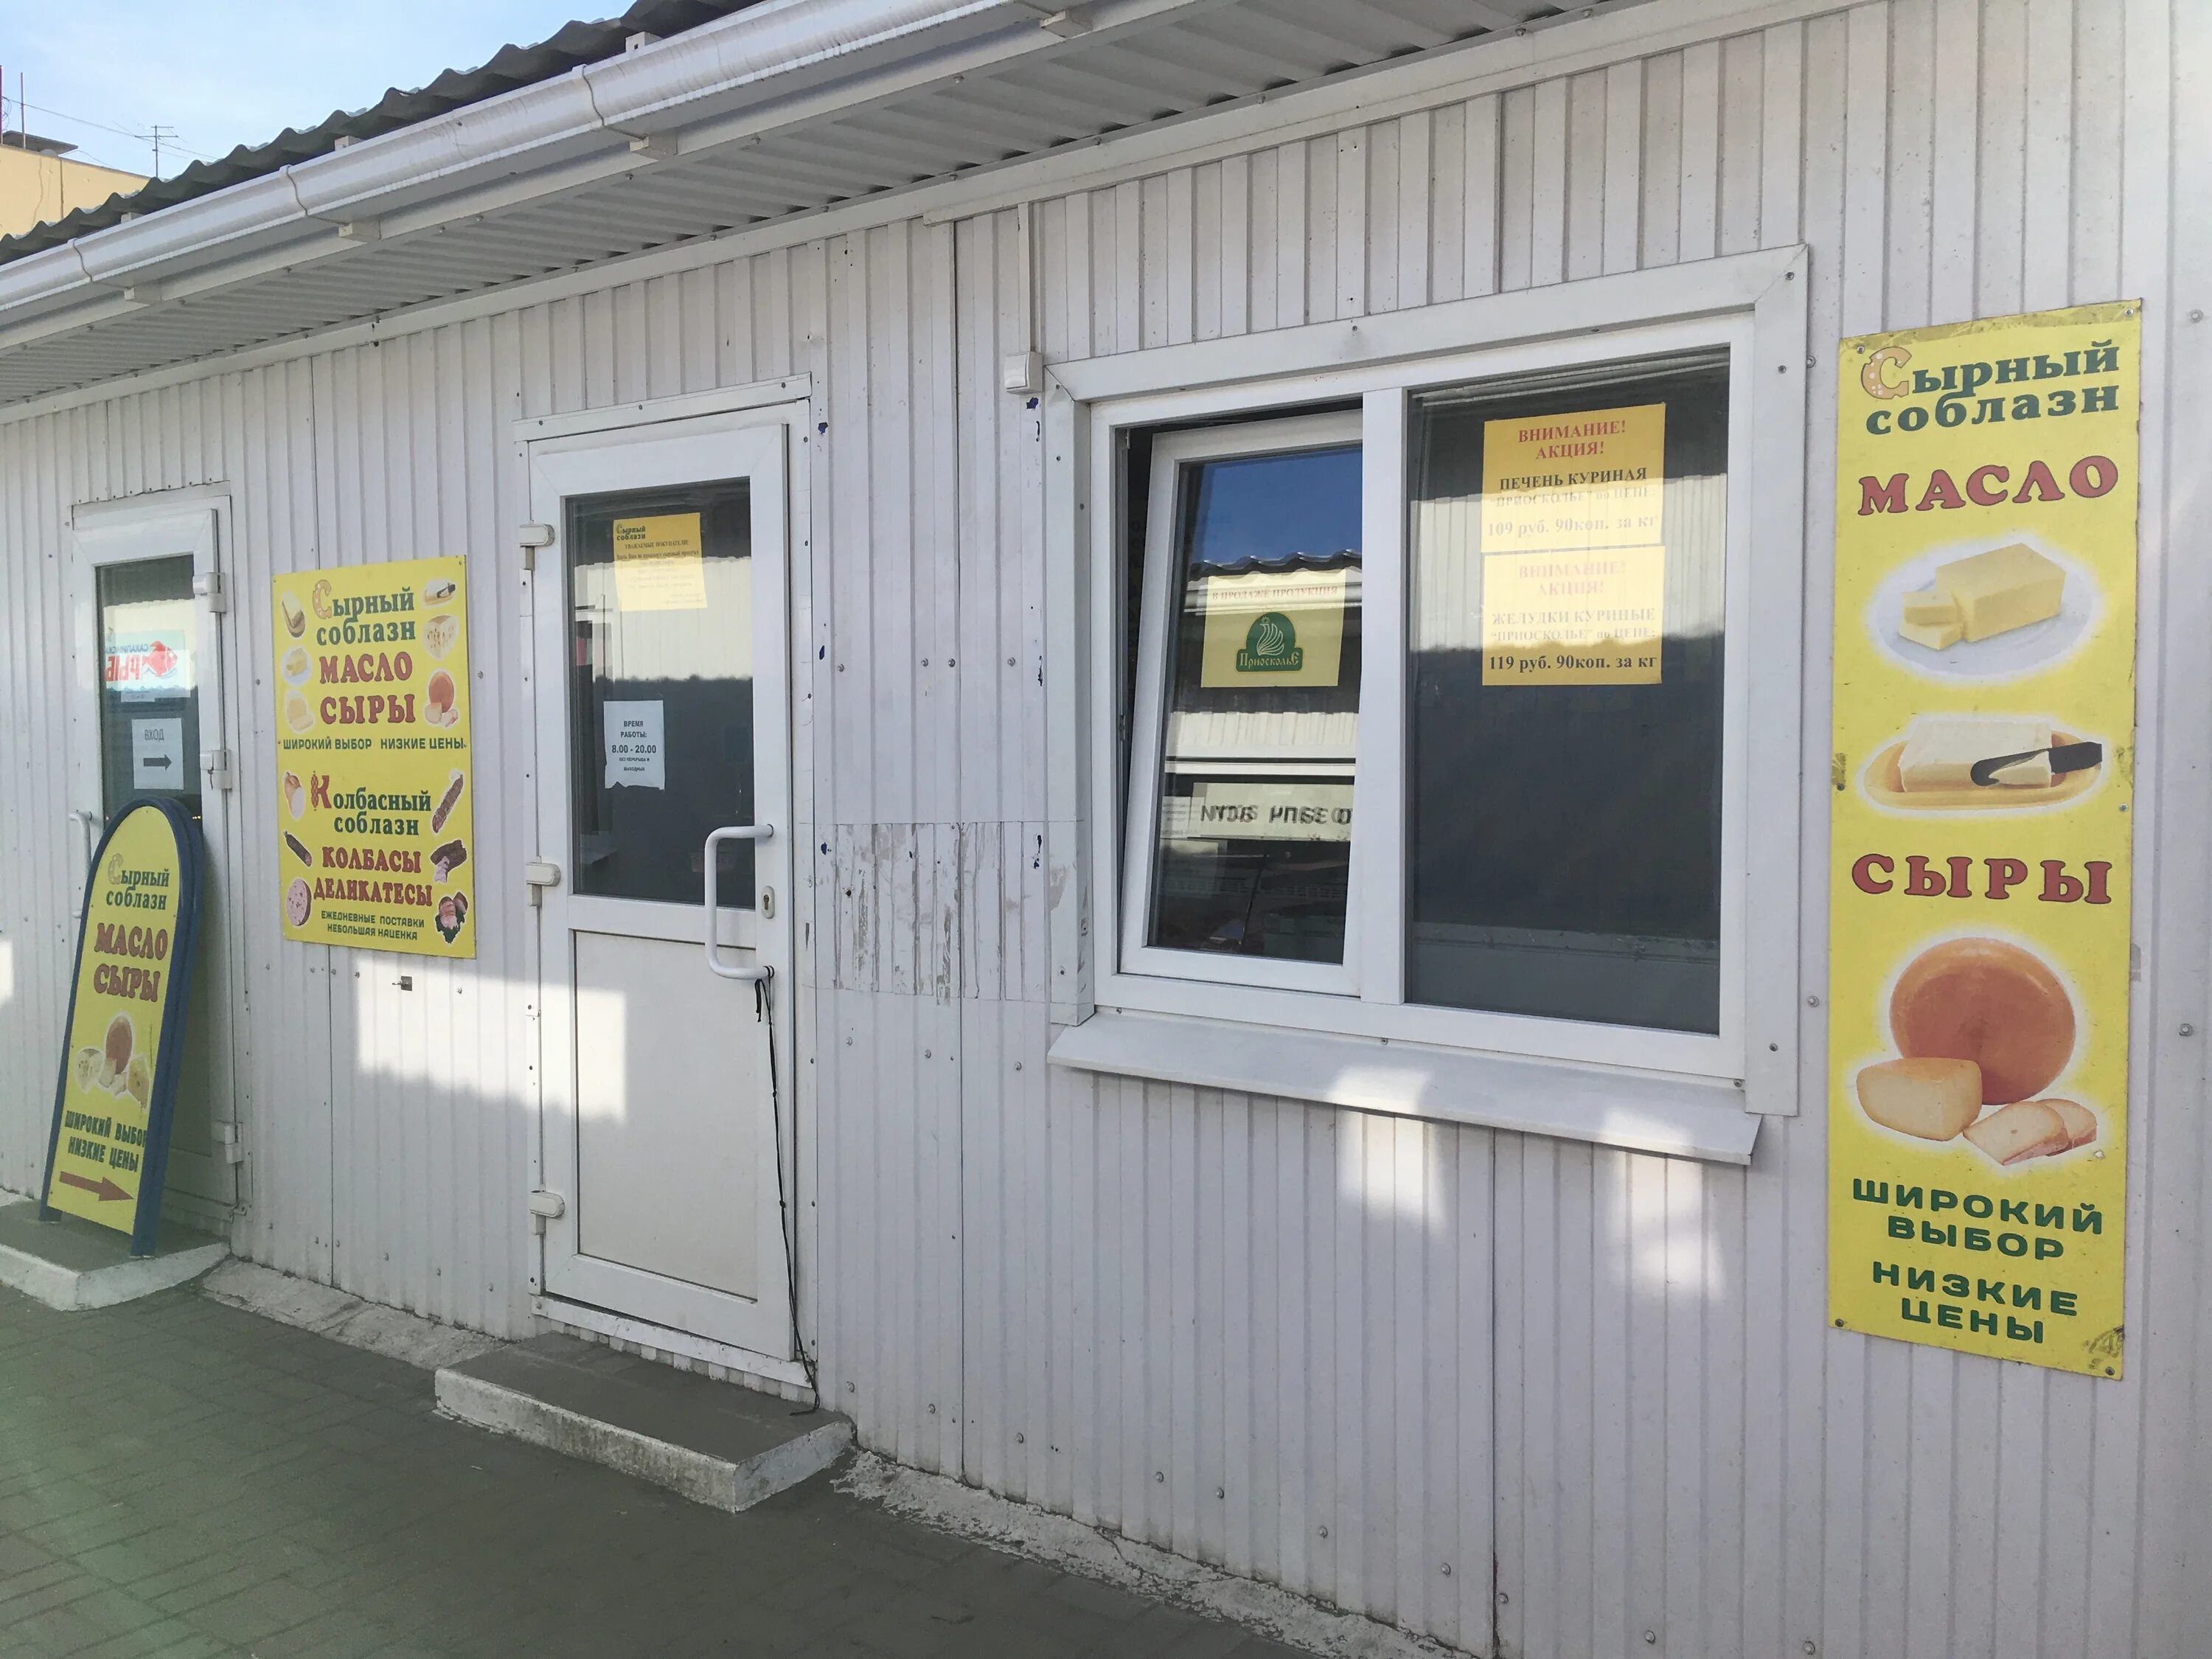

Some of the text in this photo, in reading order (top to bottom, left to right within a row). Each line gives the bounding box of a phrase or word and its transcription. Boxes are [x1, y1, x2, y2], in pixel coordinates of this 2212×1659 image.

[1860, 339, 2119, 400] Сырный
[1866, 383, 2119, 435] соблазн
[1518, 420, 1626, 442] ВНИМАНИЕ!
[1536, 442, 1604, 459] АКЦИЯ!
[1500, 467, 1647, 490] ПЕЧЕНЬ КУРИНАЯ
[1858, 455, 2118, 516] МАСЛО
[1489, 521, 1513, 537] 109
[1518, 519, 1549, 538] руб.
[1616, 518, 1632, 529] за
[1638, 515, 1655, 528] кг
[1519, 560, 1627, 579] ВНИМАНИЕ!
[313, 579, 415, 621] Сырный
[1537, 581, 1604, 597] АКЦИЯ!
[1492, 607, 1656, 625] ЖЕЛУДКИ КУРИНЫЕ
[316, 617, 415, 646] соблазн
[319, 651, 412, 684] МАСЛО
[1489, 654, 1657, 672] 119 руб. 90коп. за кг
[320, 693, 416, 725] СЫРЫ
[144, 728, 165, 742] ВХОД
[283, 736, 332, 750] ШИРОКИЙ
[335, 737, 372, 750] ВЫБОР
[380, 737, 426, 750] НИЗКИЕ
[635, 744, 657, 753] 20.00
[310, 771, 431, 812] Колбасный
[334, 810, 419, 835] соблазн
[108, 853, 170, 888] Сырный
[322, 846, 421, 874] КОЛБАСЫ
[313, 877, 433, 907] ДЕЛИКАТЕСЫ
[1852, 853, 2113, 905] СЫРЫ
[106, 886, 167, 910] соблазн
[321, 911, 425, 929] ЕЖЕДНЕВНЫЕ ПОСТАВКИ
[327, 923, 418, 941] НЕБОЛЬШАЯ НАЦЕНКА
[94, 922, 168, 961] МАСЛО
[94, 963, 161, 1002] СЫРЫ
[65, 1110, 112, 1138] ШИРОКИЙ
[68, 1135, 139, 1172] НИЗКИЕ ЦЕНЫ
[1853, 1178, 2102, 1235] ШИРОКИЙ
[1888, 1215, 2064, 1260] ВЫБОР
[1873, 1261, 2078, 1316] НИЗКИЕ
[1902, 1298, 2044, 1343] ЦЕНЫ
